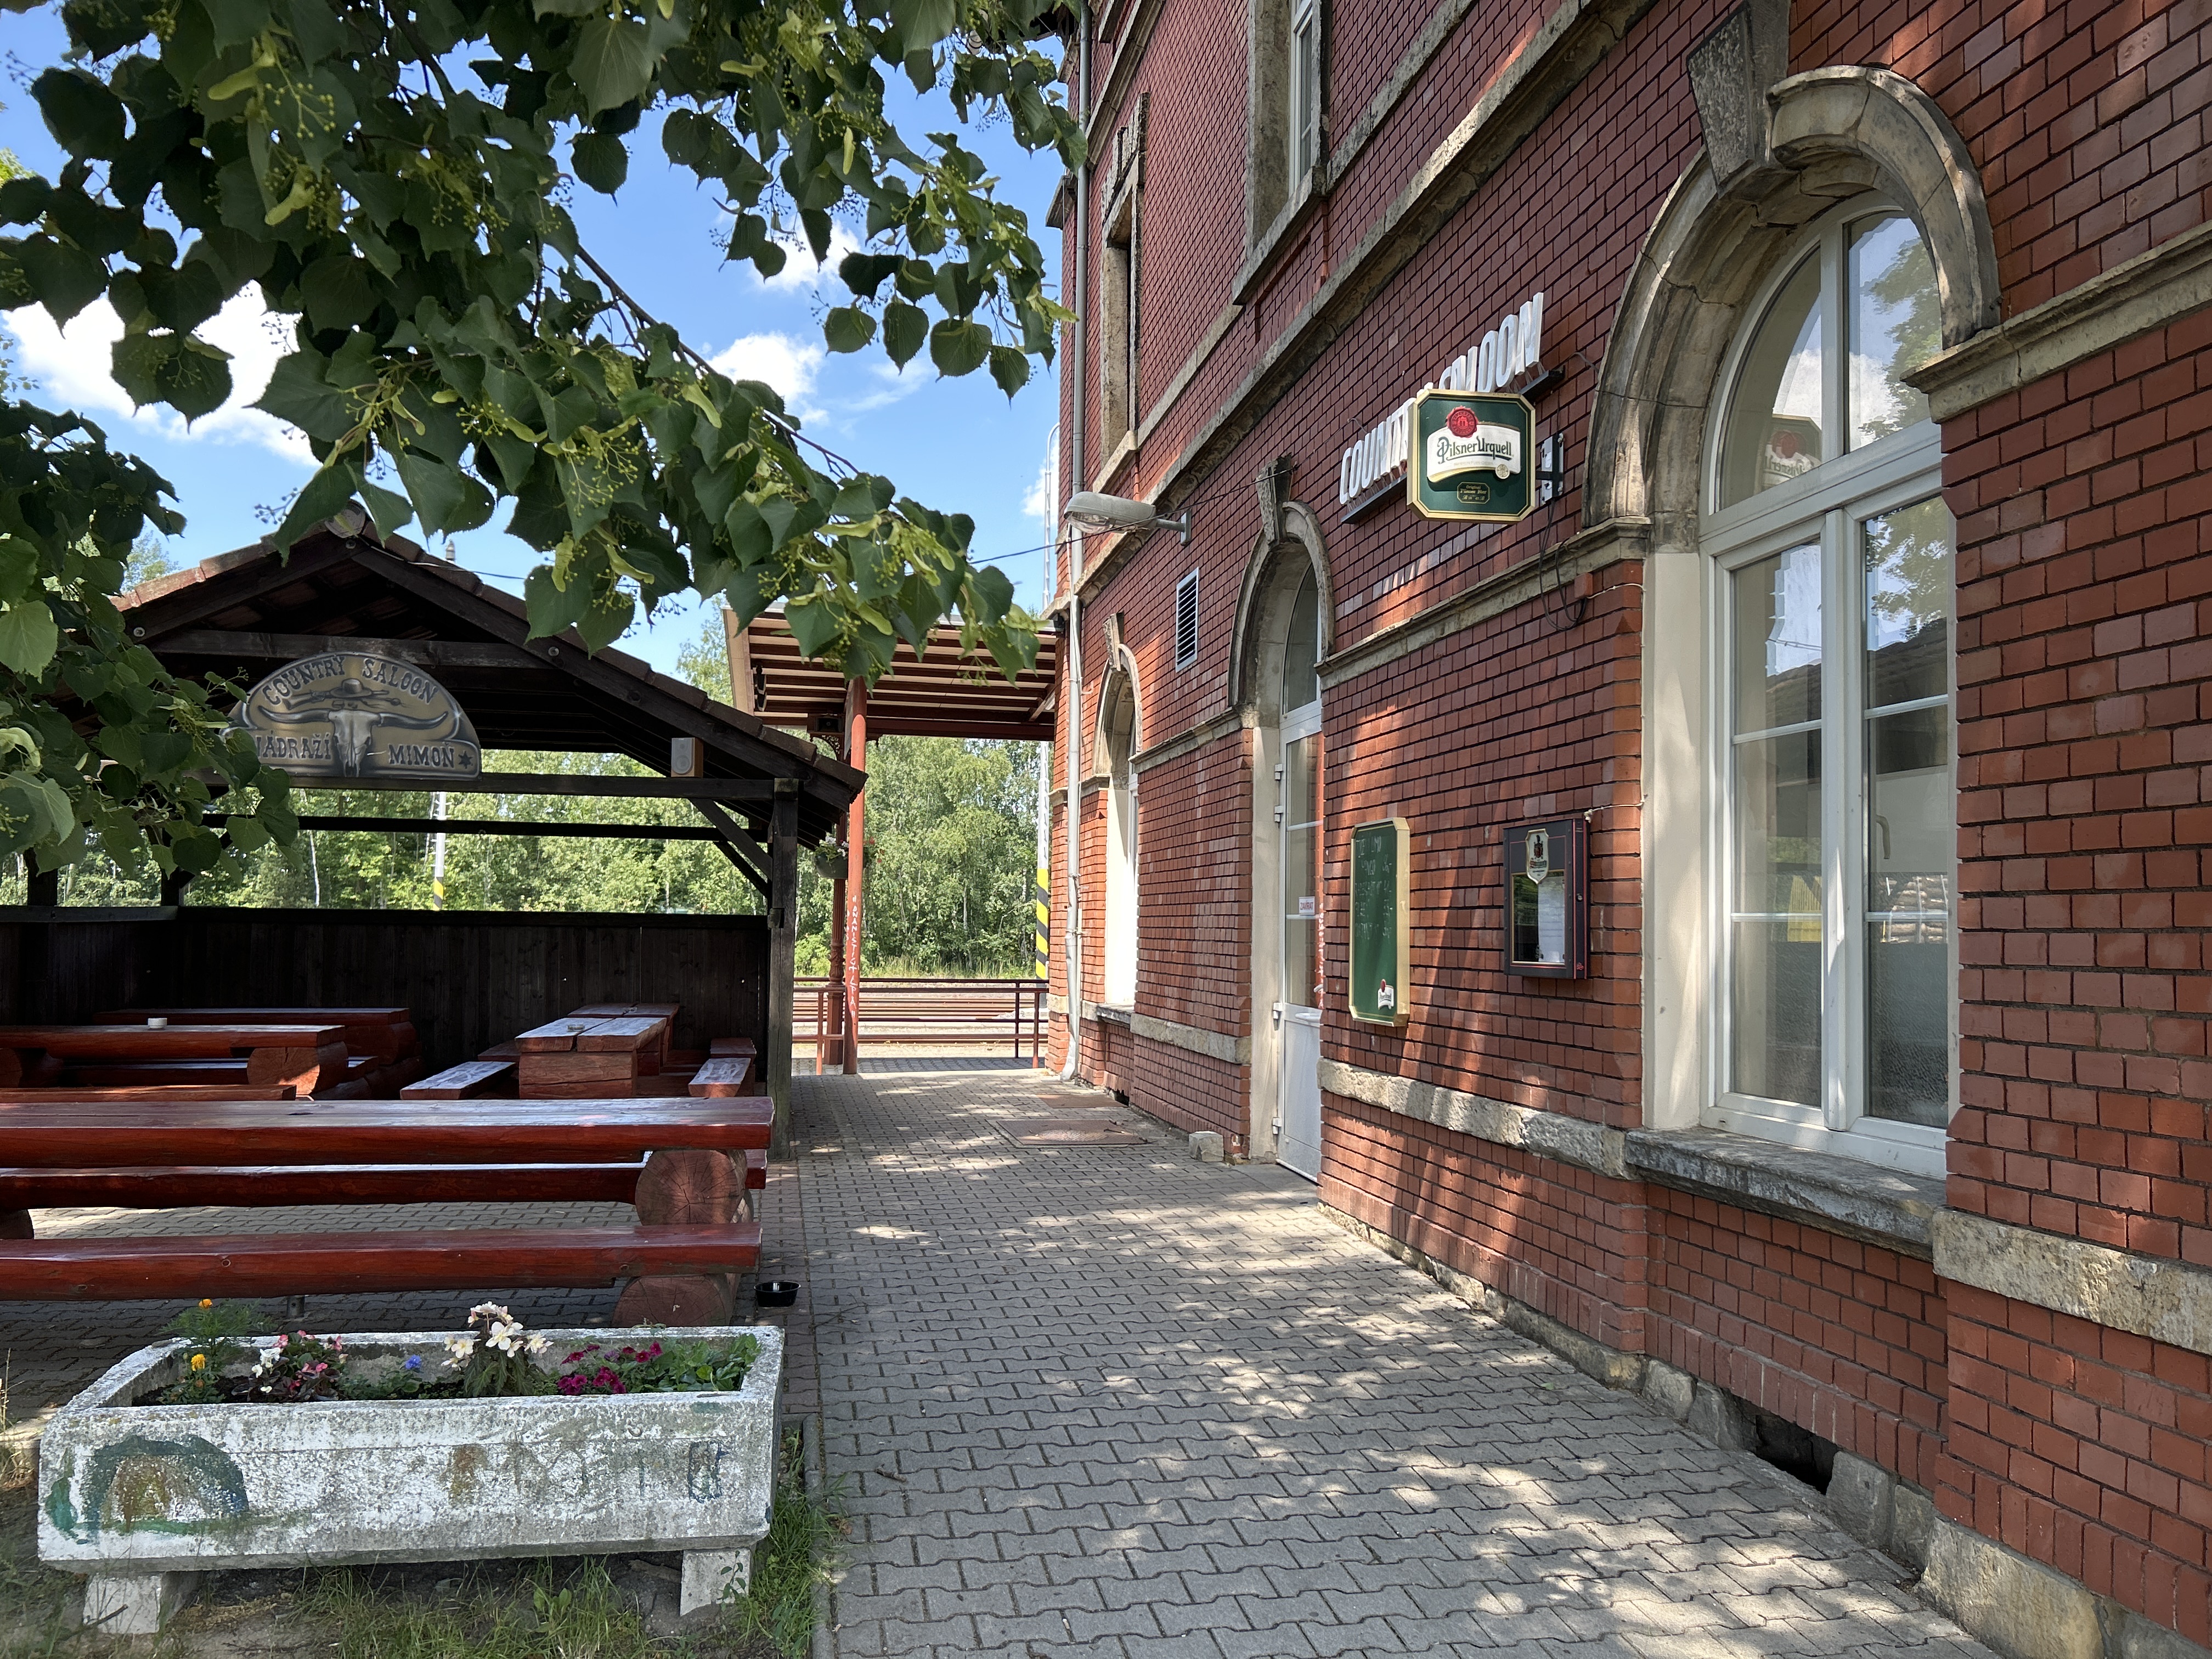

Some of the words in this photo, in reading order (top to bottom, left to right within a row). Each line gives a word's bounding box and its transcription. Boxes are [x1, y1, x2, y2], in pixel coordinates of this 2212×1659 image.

[1437, 436, 1477, 465] Pilsner
[1476, 436, 1512, 460] Urquell
[262, 656, 346, 706] COUNTRY
[362, 658, 438, 703] SALOON
[388, 741, 455, 769] MIMOŇ
